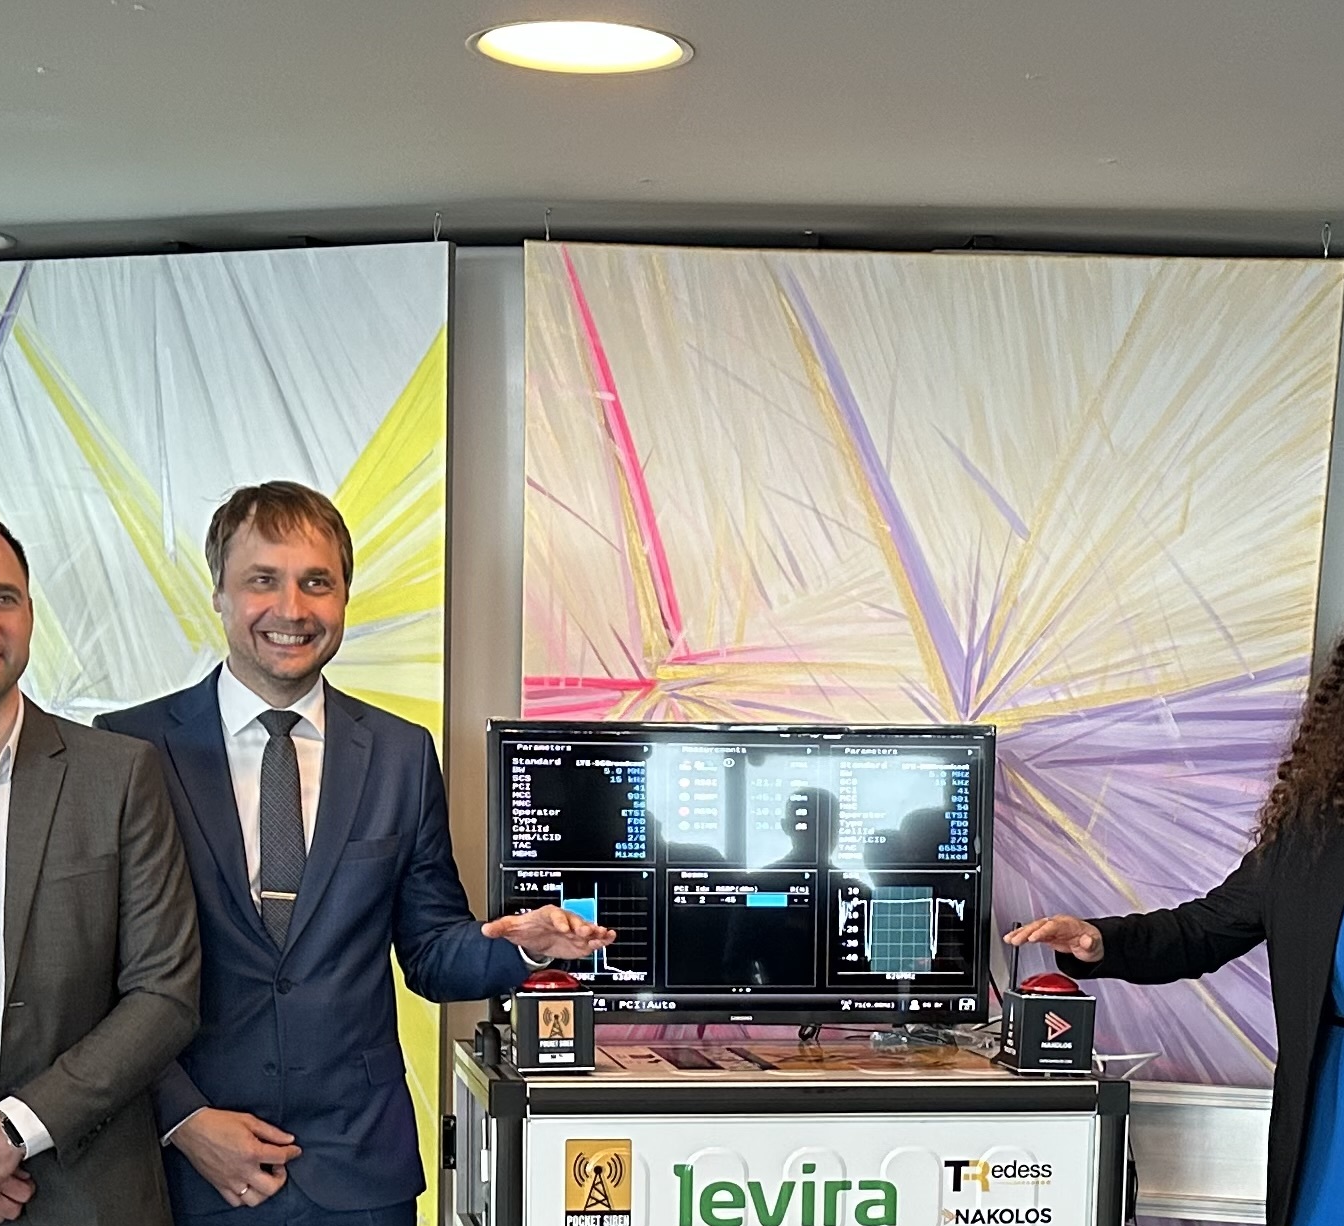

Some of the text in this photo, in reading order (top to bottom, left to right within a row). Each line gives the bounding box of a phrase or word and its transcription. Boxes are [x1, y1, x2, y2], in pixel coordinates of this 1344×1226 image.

[516, 743, 572, 751] Parameters
[512, 758, 561, 766] Standard
[512, 791, 531, 799] MCC
[512, 808, 646, 817] Operator ETSI
[512, 817, 537, 825] Type
[839, 819, 863, 827] Type
[517, 870, 562, 878] Spectrum
[674, 896, 687, 904] 41
[699, 896, 706, 904] 2
[955, 1208, 1052, 1224] NAKOLOS
[603, 1215, 630, 1226] SIREN
